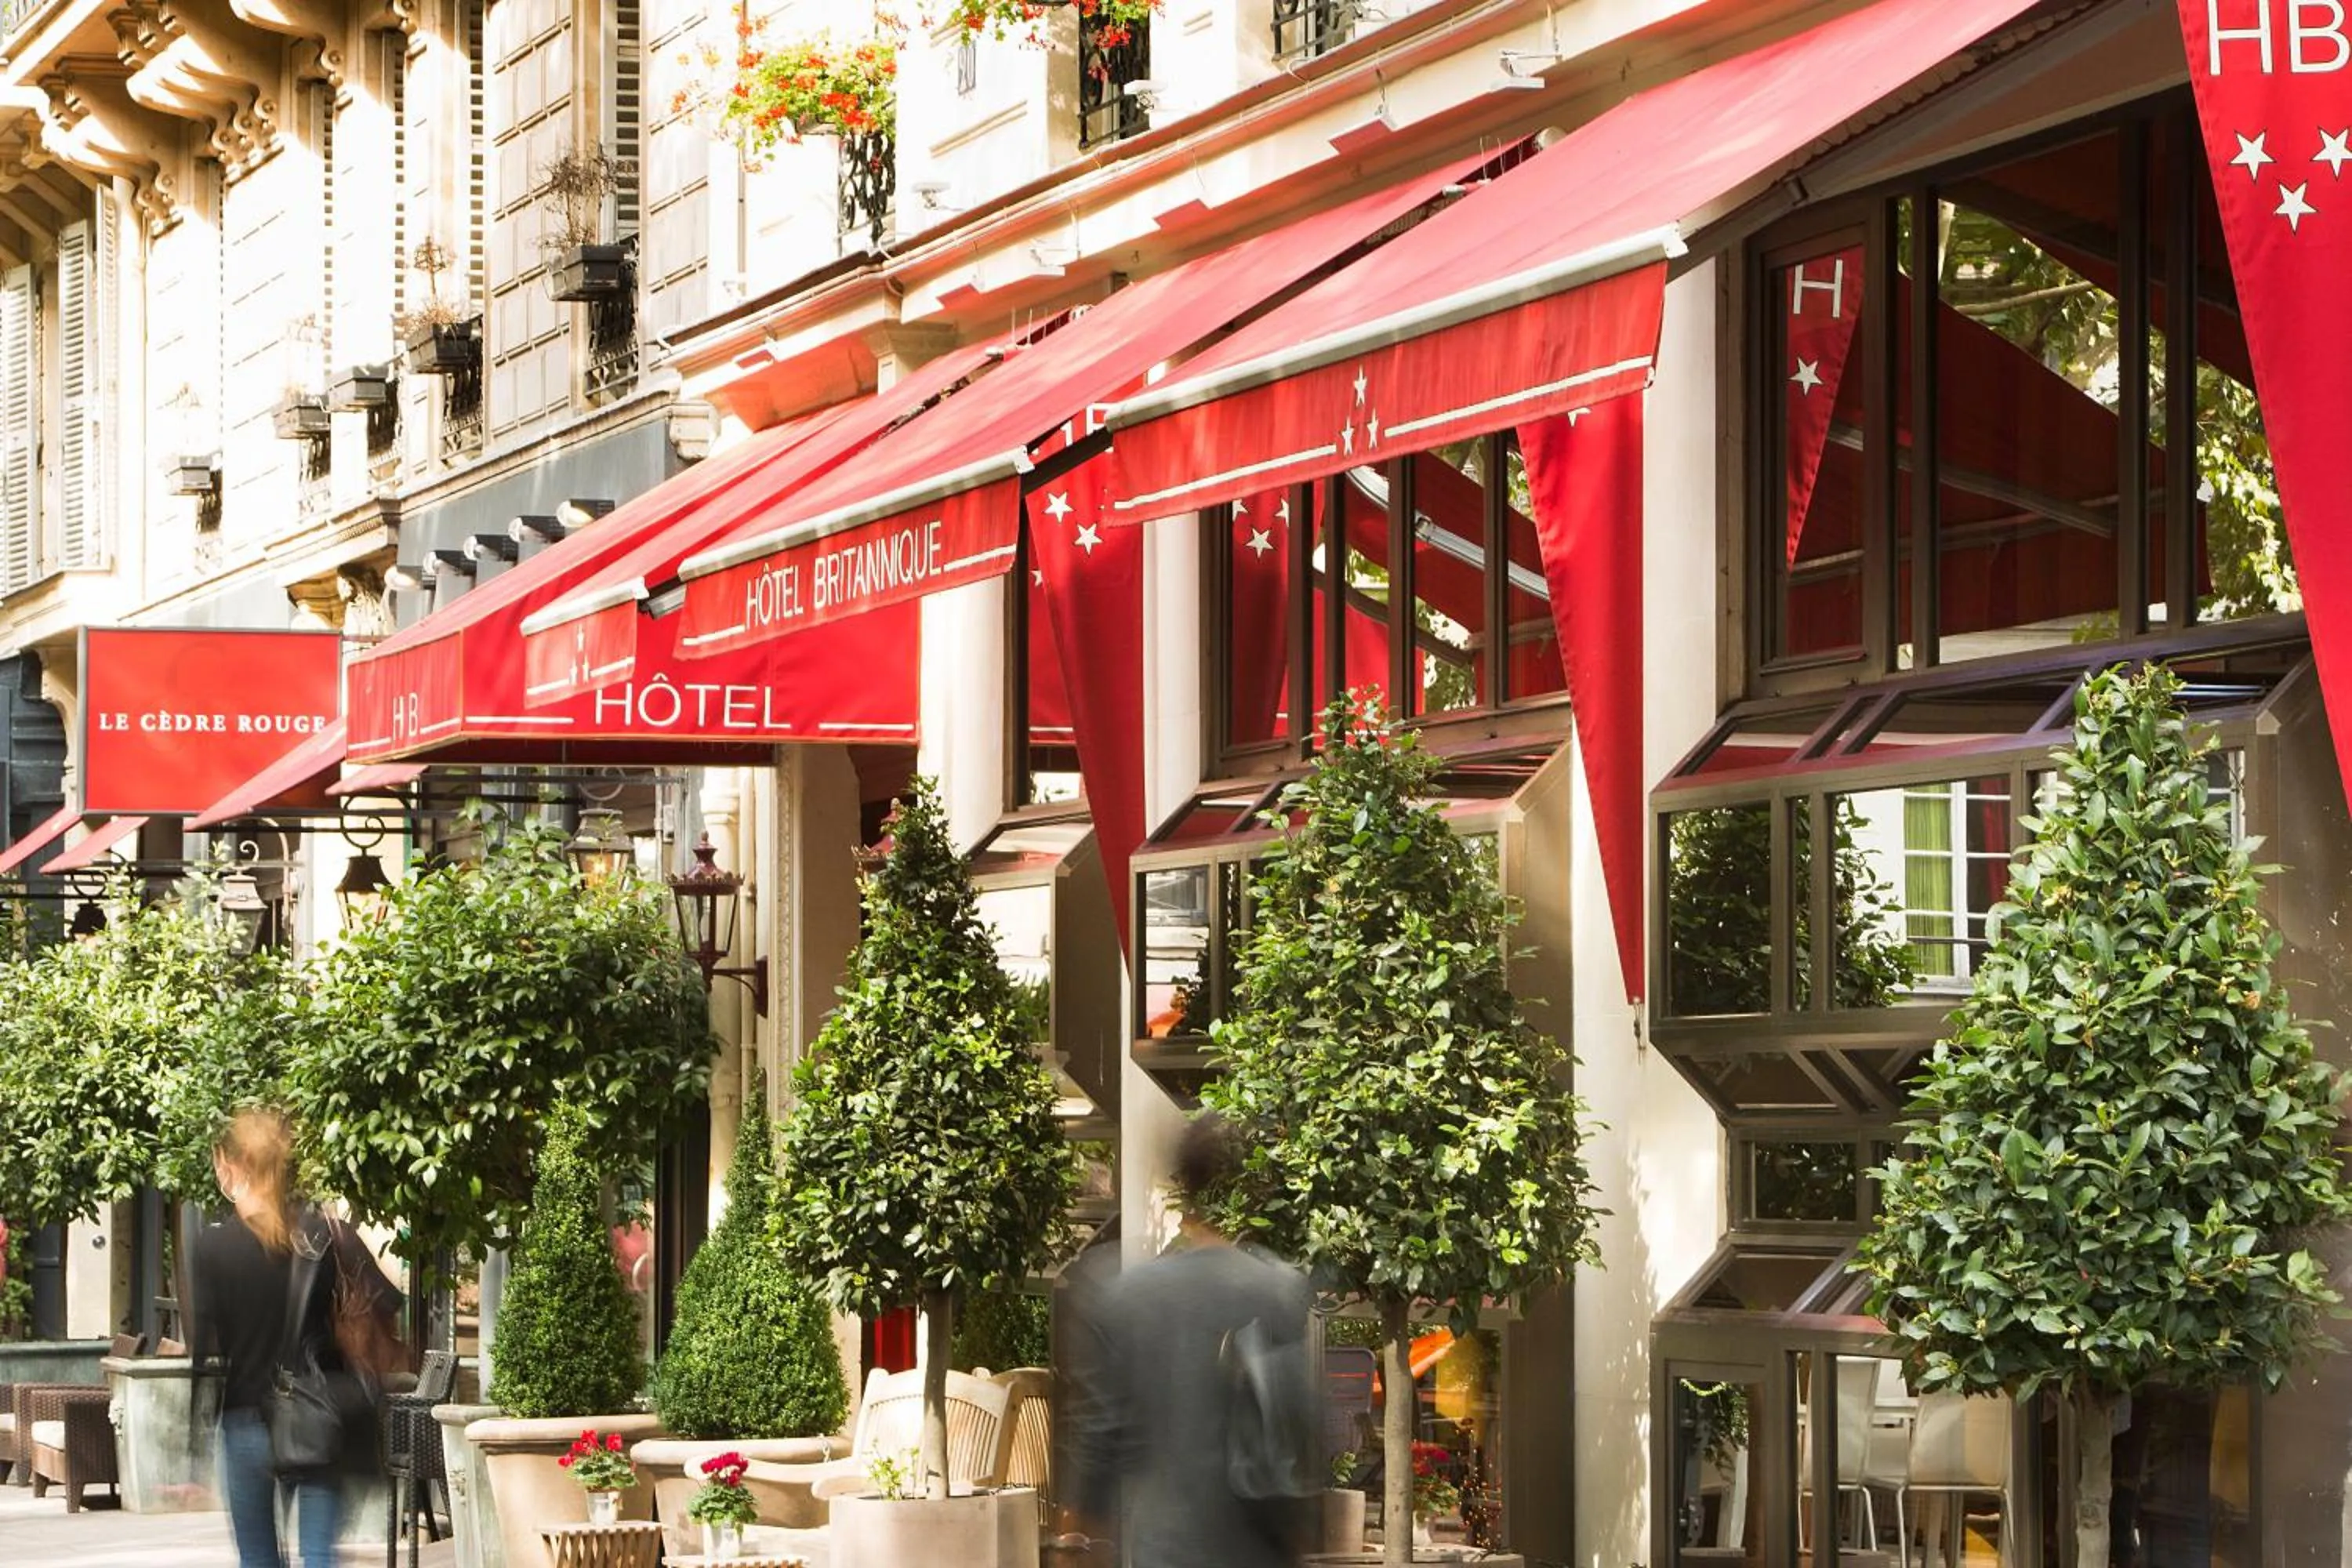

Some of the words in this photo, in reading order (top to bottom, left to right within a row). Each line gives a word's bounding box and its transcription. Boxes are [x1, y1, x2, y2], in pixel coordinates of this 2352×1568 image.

[2208, 0, 2350, 75] HB
[746, 562, 804, 630] HÔTEL
[814, 520, 941, 610] BRITANNIQUE
[100, 713, 129, 731] LE
[140, 710, 227, 732] CÈDRE
[238, 714, 326, 733] ROUGE
[596, 672, 791, 728] HÔTEL
